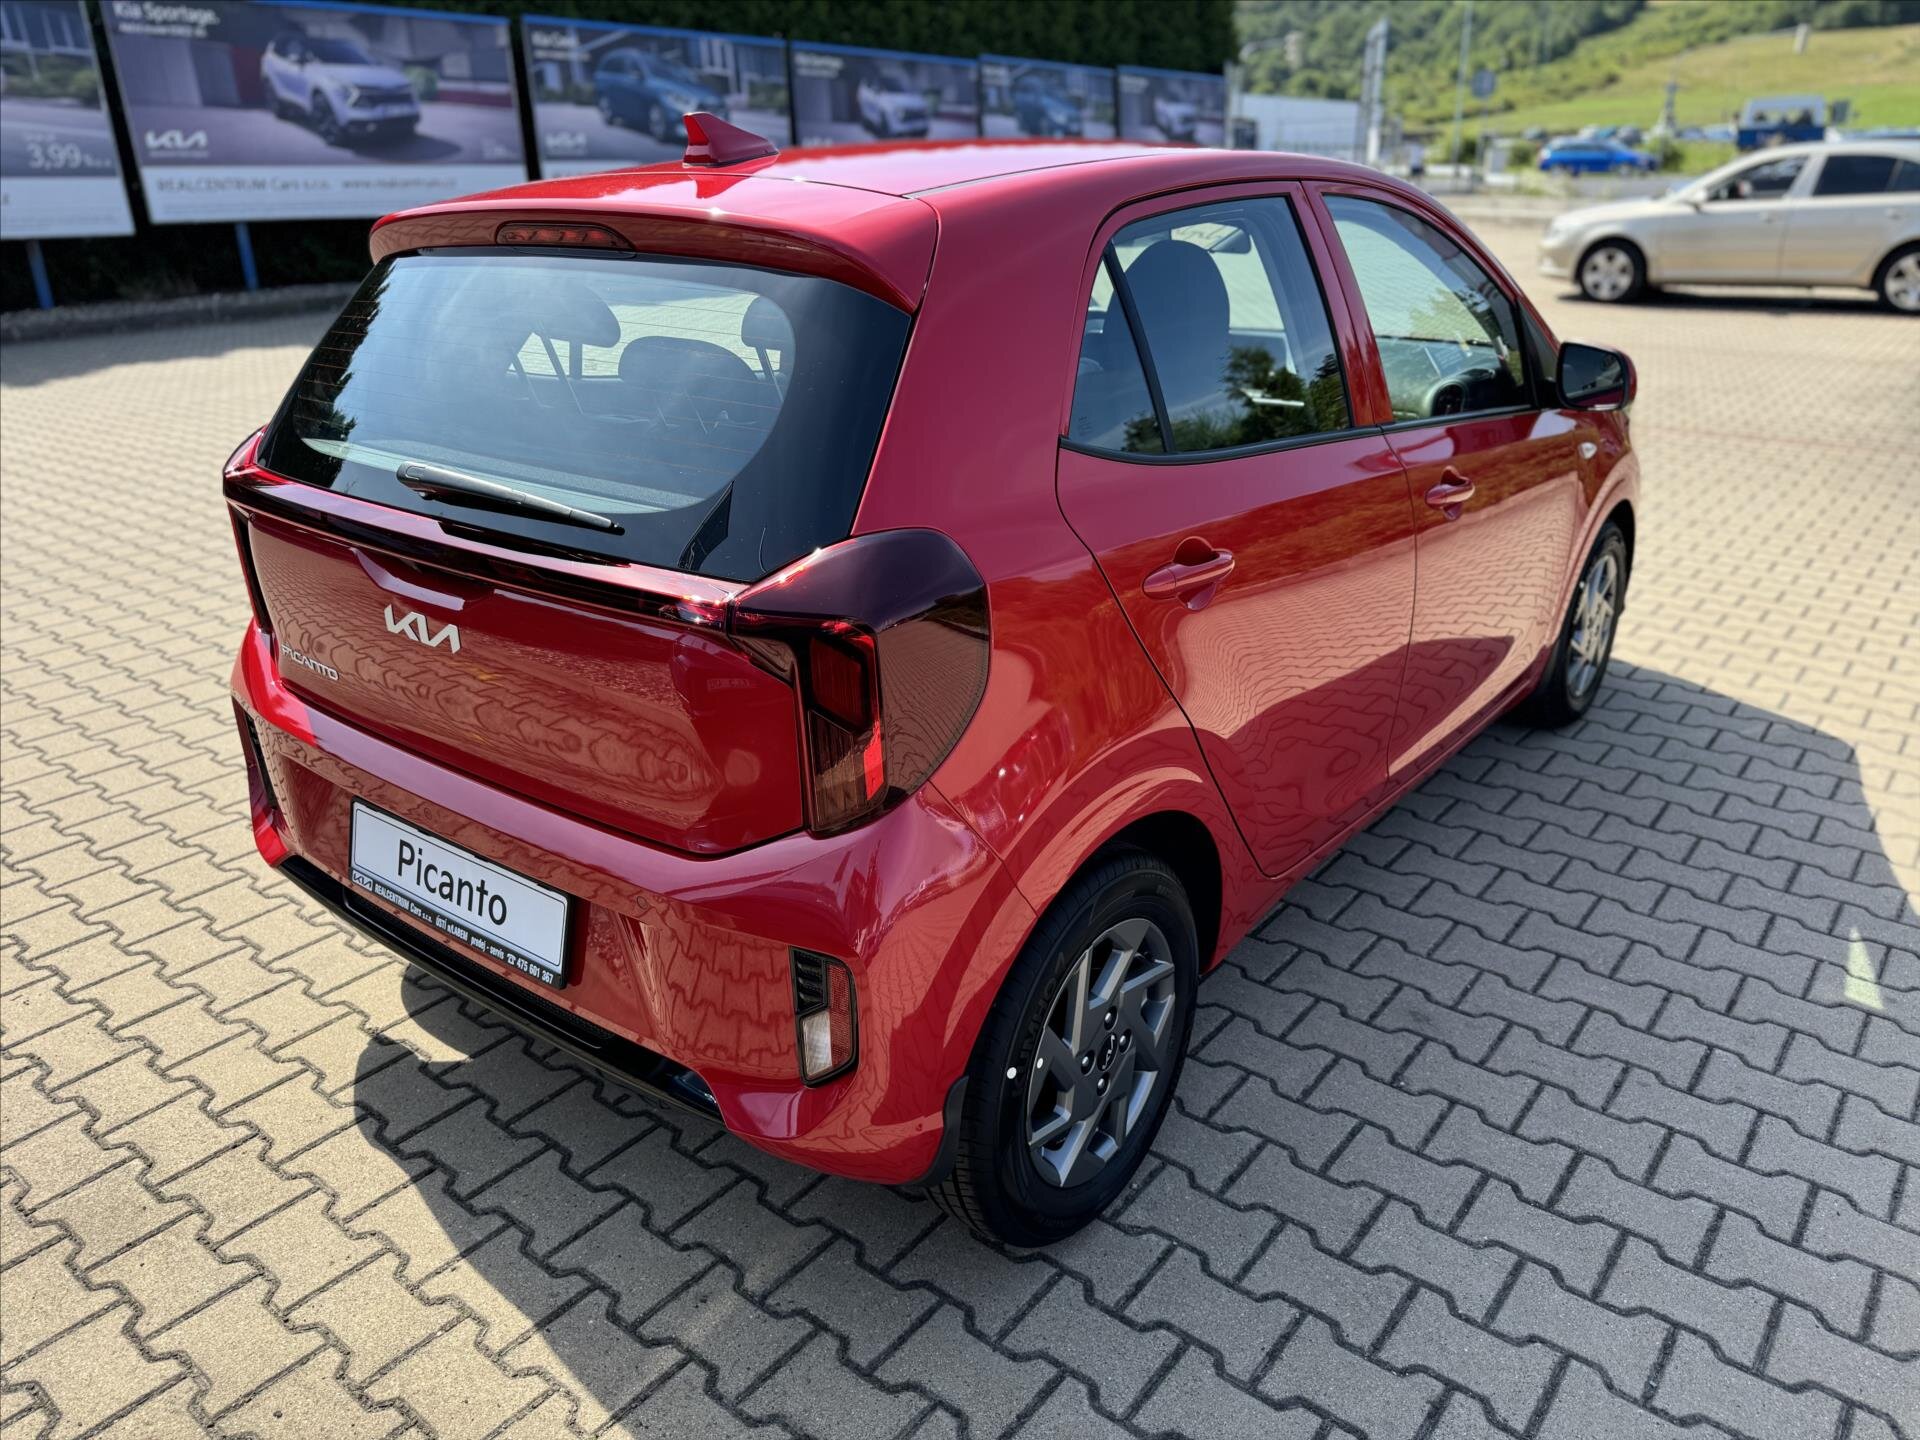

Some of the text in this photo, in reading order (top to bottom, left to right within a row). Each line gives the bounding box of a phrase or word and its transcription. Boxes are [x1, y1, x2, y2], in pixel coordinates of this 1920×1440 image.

[281, 643, 339, 681] PICANTO
[384, 604, 461, 654] KIA
[398, 839, 507, 926] Picanto
[374, 883, 410, 911] REALCENTRUM
[410, 902, 421, 917] Cars
[516, 956, 529, 972] 475
